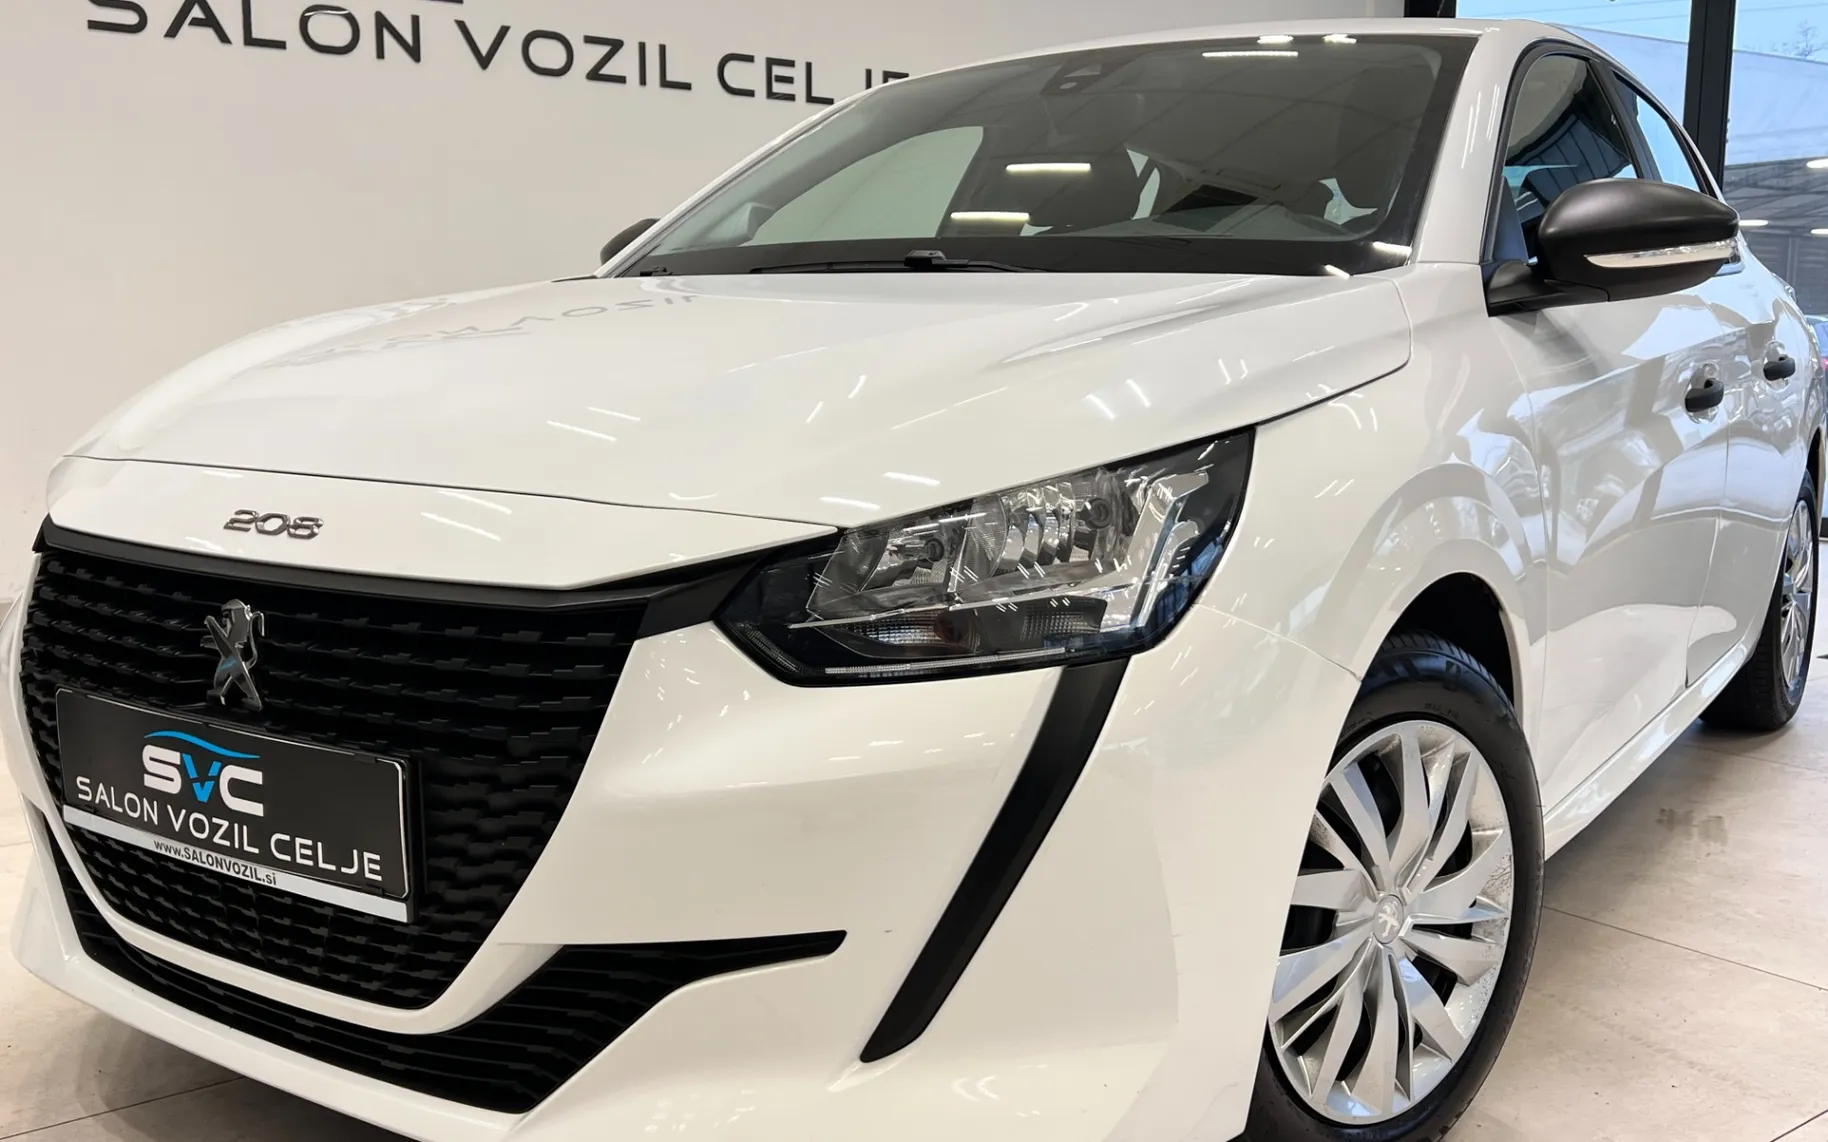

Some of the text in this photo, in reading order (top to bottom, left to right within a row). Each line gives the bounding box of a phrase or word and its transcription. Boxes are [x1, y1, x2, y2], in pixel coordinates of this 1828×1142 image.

[454, 19, 692, 90] VOZIL
[717, 52, 909, 105] CEL
[223, 508, 324, 540] 208
[142, 744, 264, 817] SVC
[76, 775, 383, 881] SALON VOZIL CELJE
[153, 840, 277, 886] www.SALONVOZIL.si
